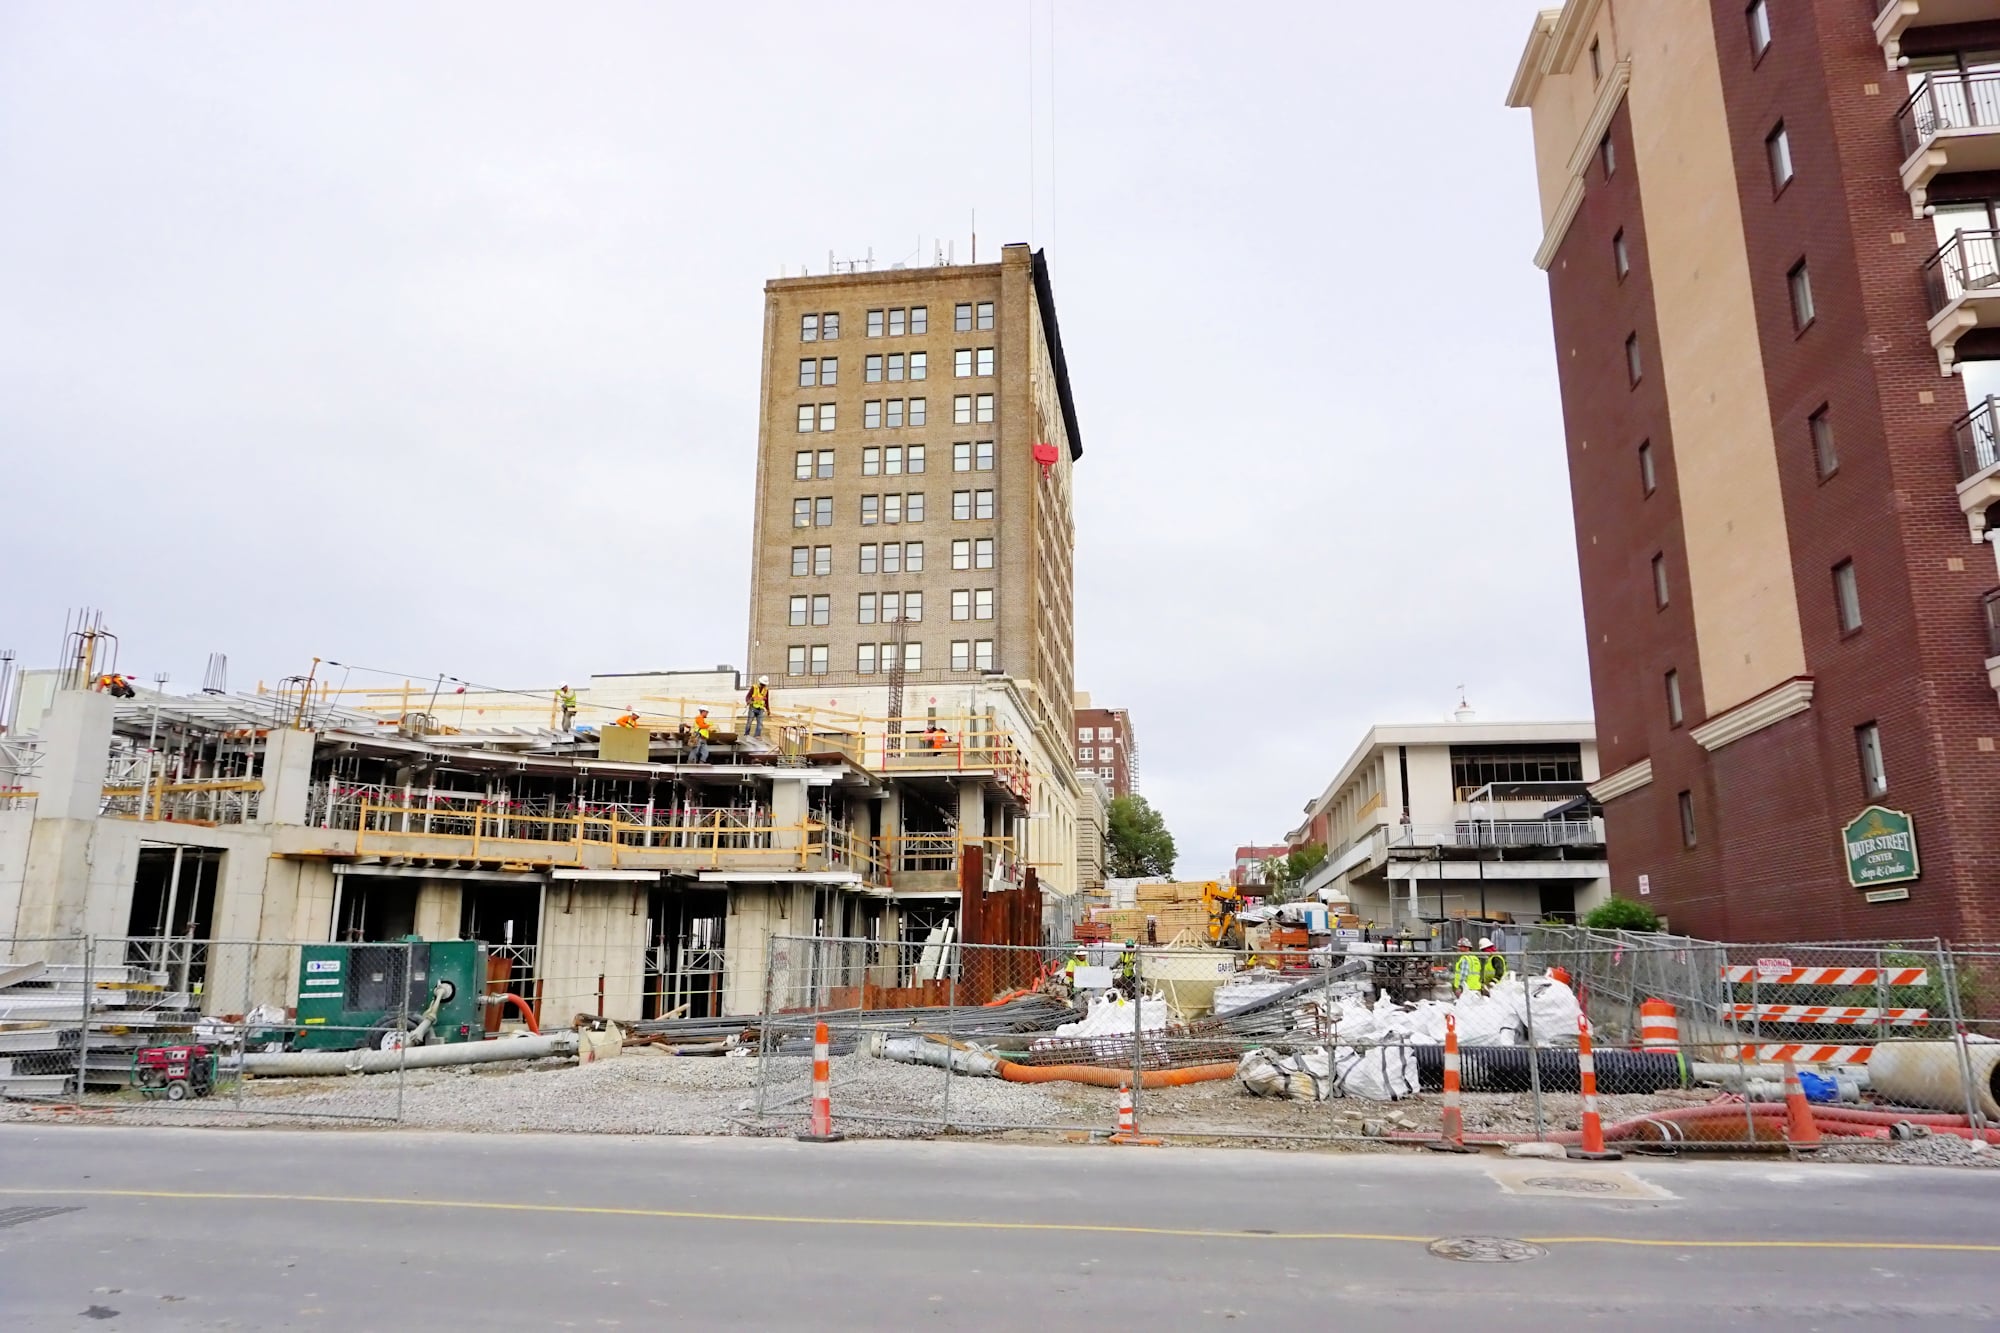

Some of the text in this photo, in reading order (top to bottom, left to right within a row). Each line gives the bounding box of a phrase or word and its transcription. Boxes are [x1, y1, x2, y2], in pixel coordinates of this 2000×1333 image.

[1848, 832, 1910, 861] WATER STREET
[1867, 852, 1893, 864] CENTER
[1759, 959, 1790, 967] NATIONAL
